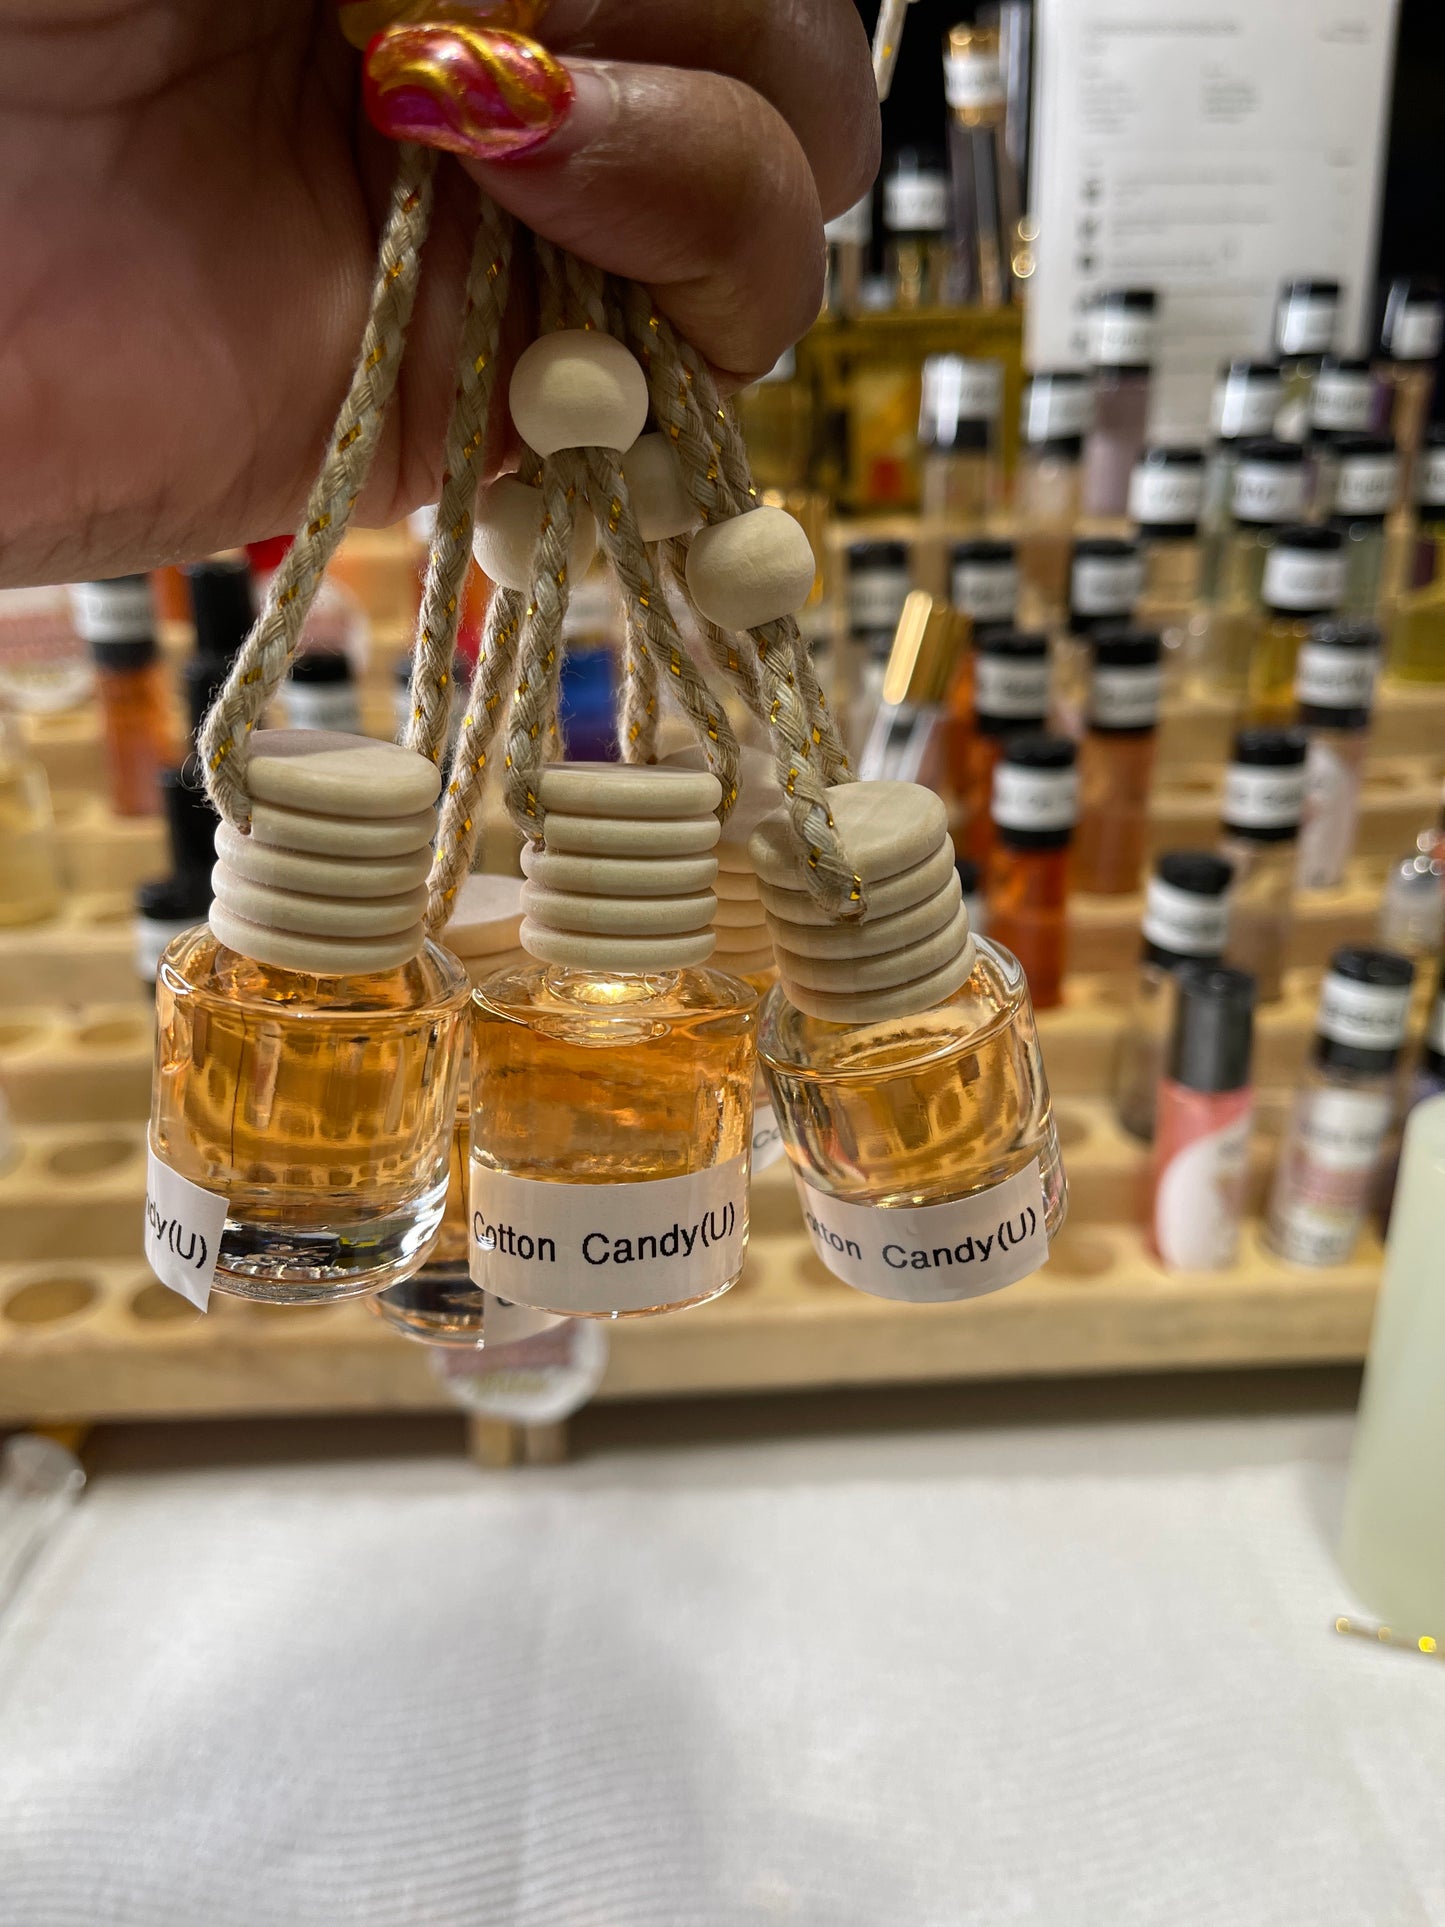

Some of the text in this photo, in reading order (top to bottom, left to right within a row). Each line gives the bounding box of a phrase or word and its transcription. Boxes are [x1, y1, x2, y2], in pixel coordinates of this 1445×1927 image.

[473, 1201, 735, 1265] Cotton Candy(U)
[882, 1207, 1037, 1270] Candy(U)
